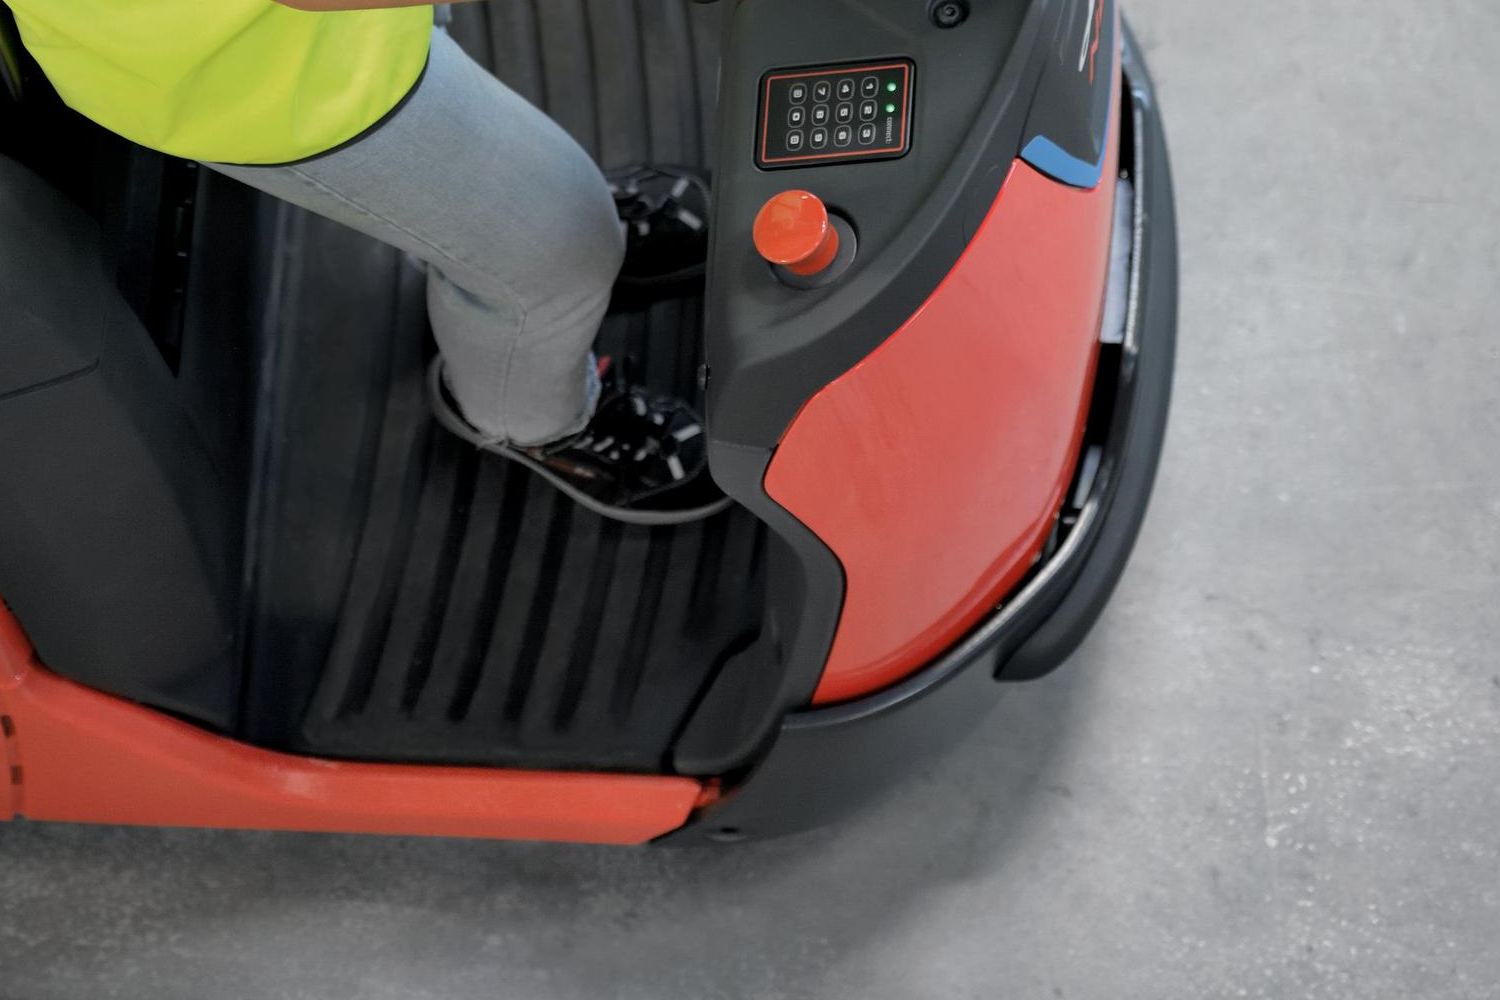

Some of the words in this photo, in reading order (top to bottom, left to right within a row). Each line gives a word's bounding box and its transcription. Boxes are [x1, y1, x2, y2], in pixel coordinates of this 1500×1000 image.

[818, 87, 826, 96] 7
[842, 84, 850, 93] 4
[816, 110, 824, 119] 8
[840, 107, 849, 117] 5
[864, 105, 872, 115] 2
[814, 133, 823, 142] 9
[838, 131, 847, 140] 6
[862, 129, 871, 138] 3
